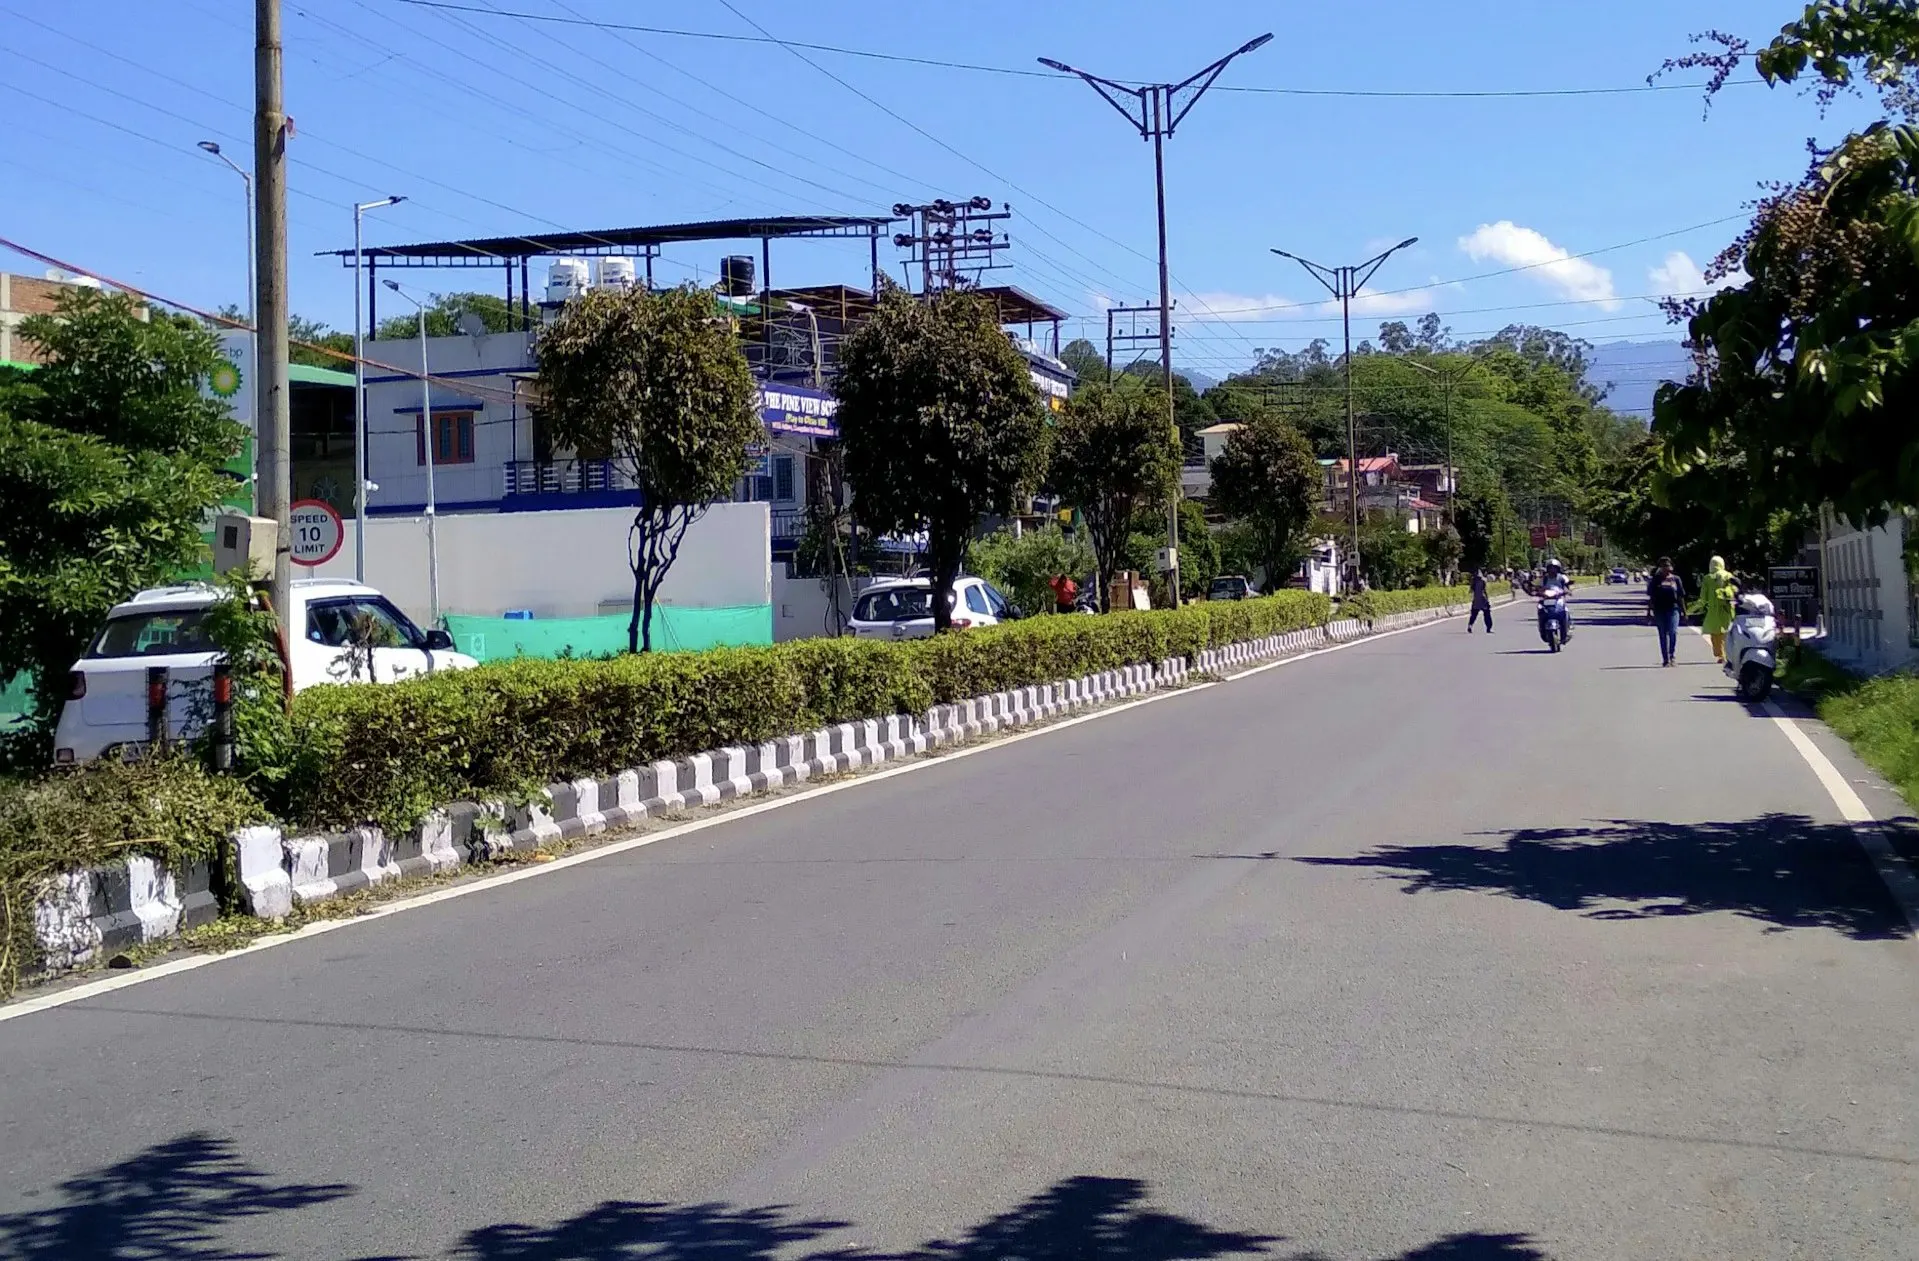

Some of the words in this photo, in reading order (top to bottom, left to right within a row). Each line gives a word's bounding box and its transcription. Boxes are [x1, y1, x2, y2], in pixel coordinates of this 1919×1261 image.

[229, 346, 243, 359] bp
[764, 391, 781, 410] THE
[781, 394, 801, 413] PINE
[800, 397, 821, 415] VIEW
[290, 514, 328, 524] SPEED
[299, 526, 321, 542] 10
[294, 543, 326, 555] LIMIT
